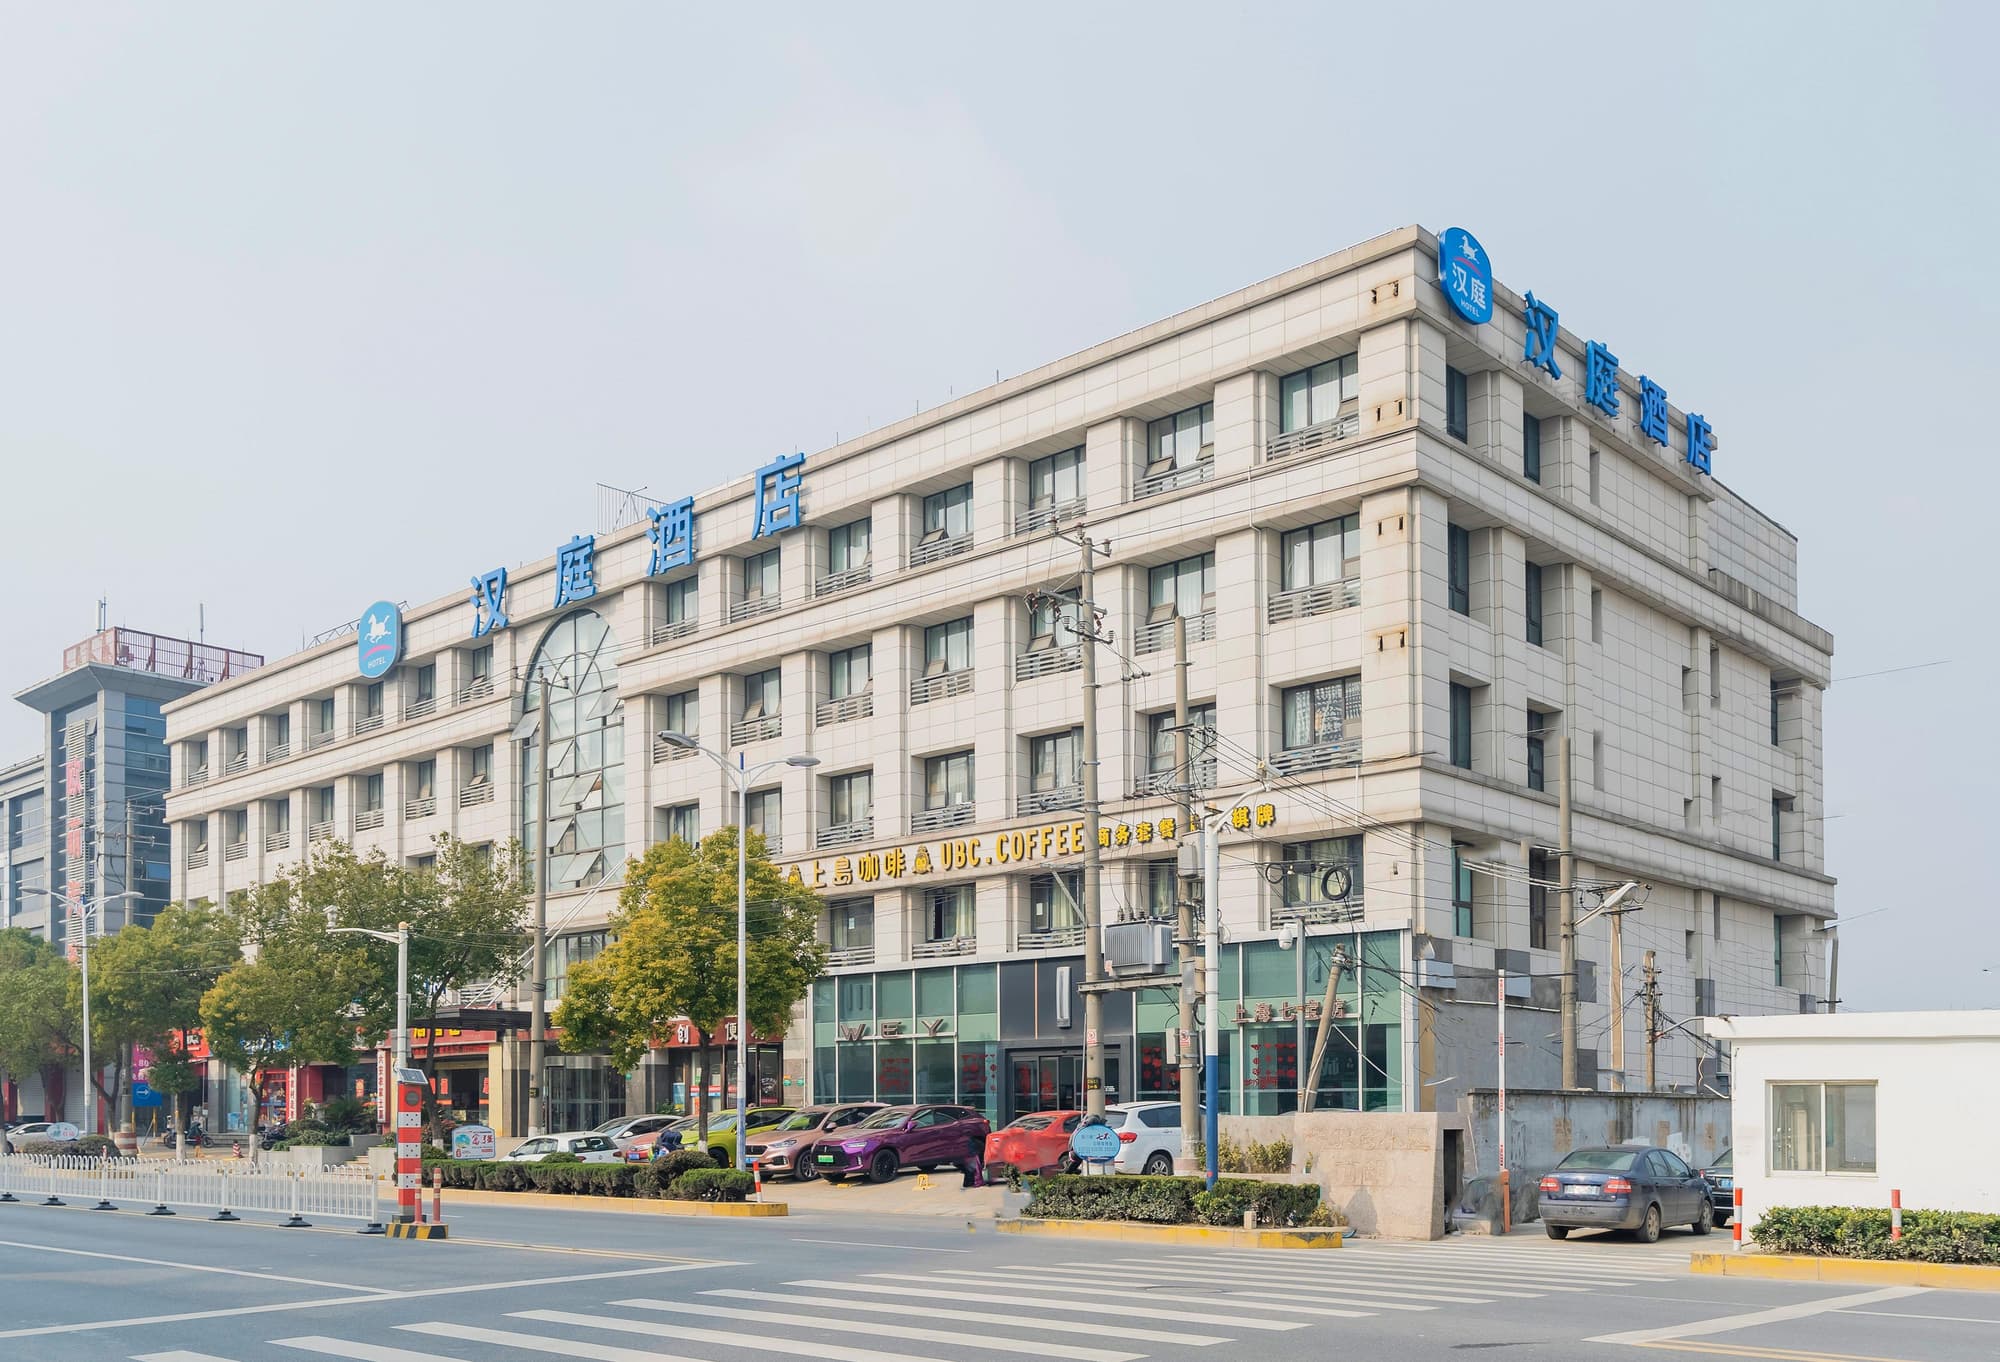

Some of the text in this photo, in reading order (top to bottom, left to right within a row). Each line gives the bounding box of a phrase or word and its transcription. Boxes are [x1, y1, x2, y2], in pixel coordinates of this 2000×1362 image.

[1452, 262, 1486, 311] 汉庭
[1460, 298, 1481, 318] HOTEL
[1524, 289, 1713, 476] 汉庭酒店
[470, 452, 806, 639] 汉庭酒店
[367, 656, 386, 669] HOTEL
[840, 1018, 944, 1041] WEY
